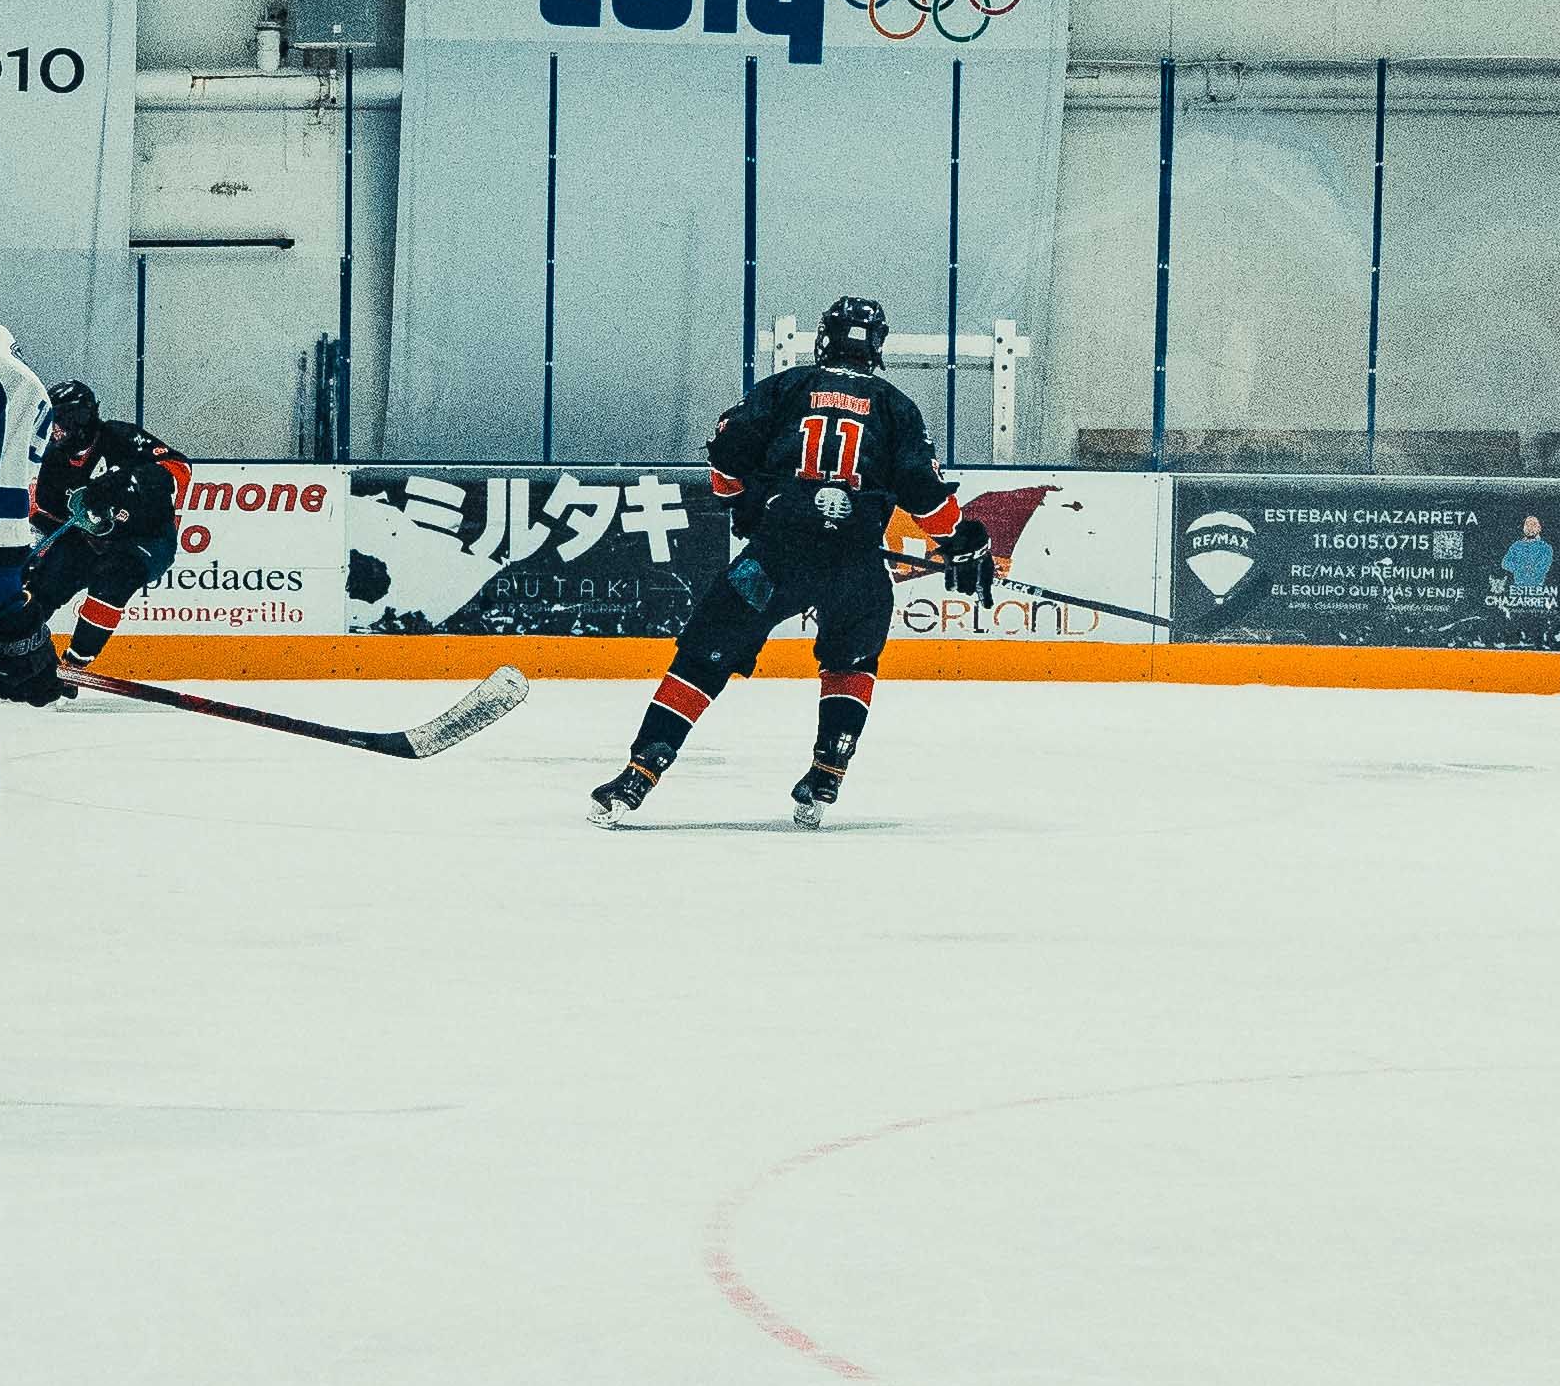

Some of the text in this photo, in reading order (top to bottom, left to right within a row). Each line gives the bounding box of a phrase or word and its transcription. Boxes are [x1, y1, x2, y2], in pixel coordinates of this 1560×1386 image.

[794, 415, 865, 490] 11
[1264, 508, 1480, 527] ESTEBAN CHAZARRETA
[1192, 533, 1249, 550] RE/MAX
[1290, 564, 1362, 580] RE/MAX
[1363, 565, 1436, 581] PREMIUM
[481, 577, 641, 599] RUTAKI
[1291, 585, 1345, 598] EQUIPO
[1348, 586, 1379, 599] QUE
[1416, 586, 1465, 600] VENDE
